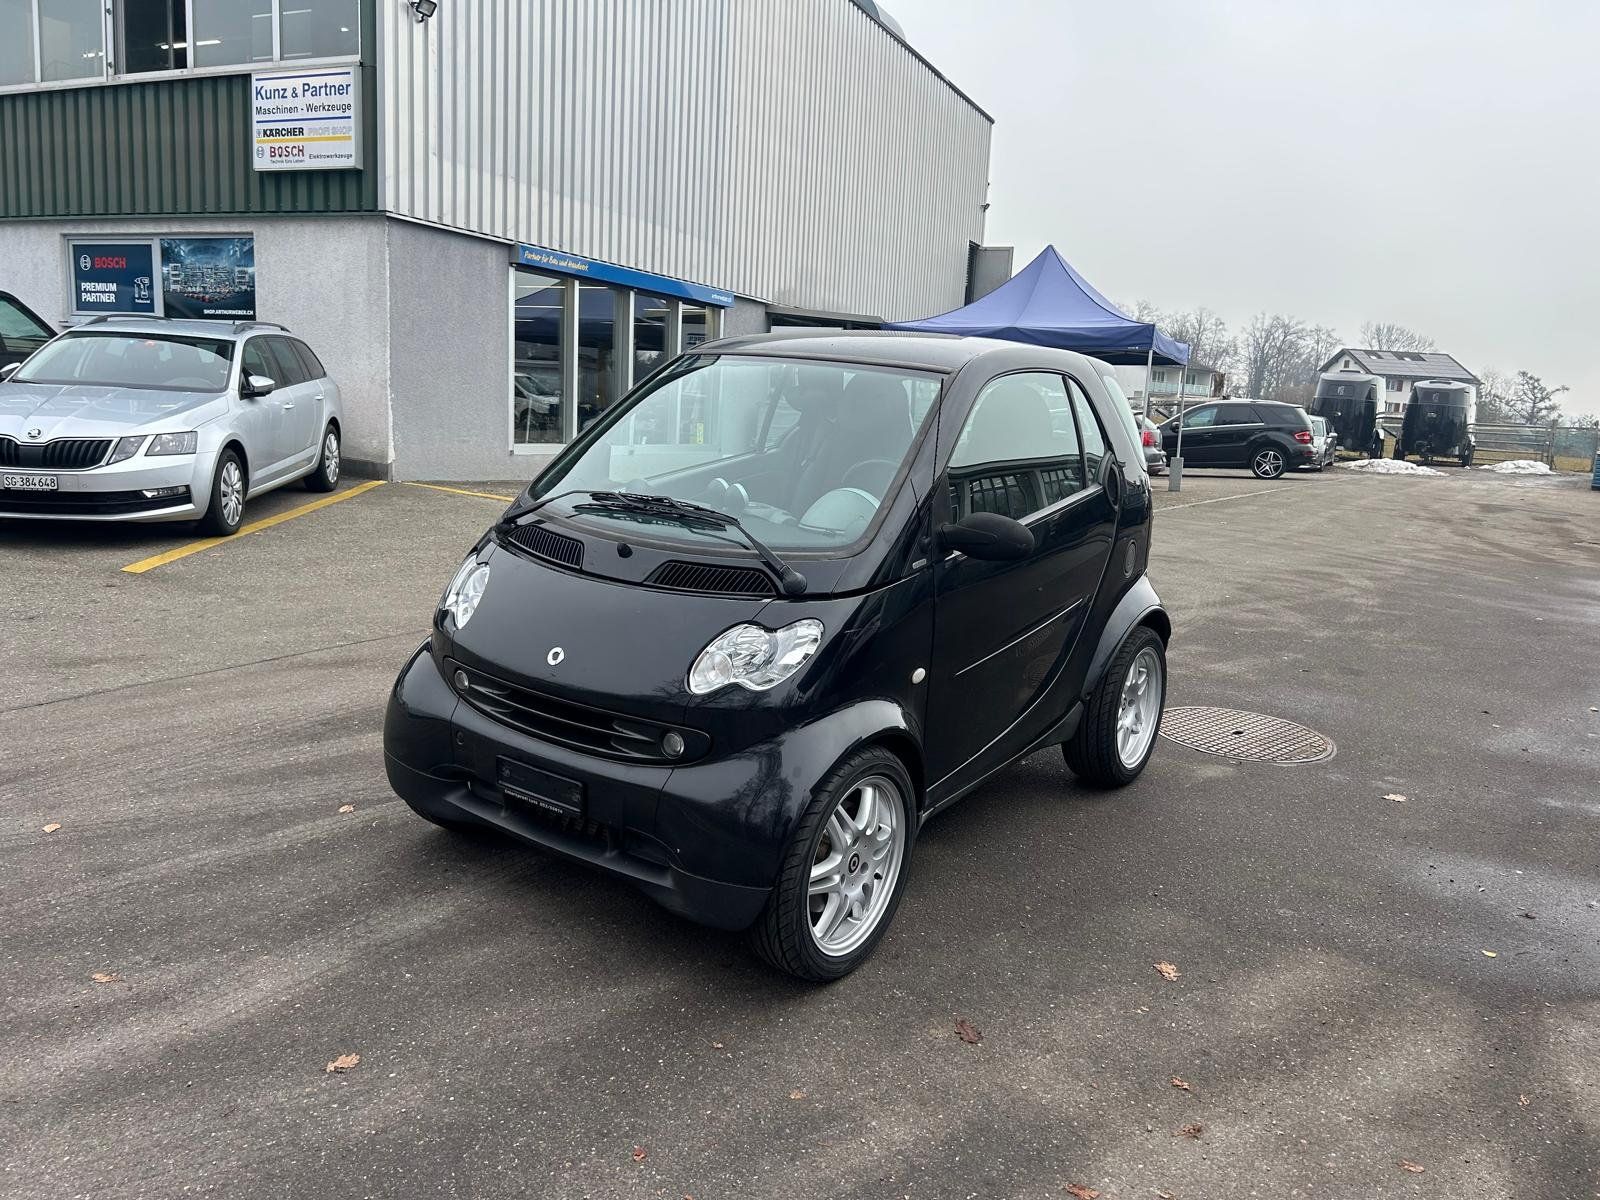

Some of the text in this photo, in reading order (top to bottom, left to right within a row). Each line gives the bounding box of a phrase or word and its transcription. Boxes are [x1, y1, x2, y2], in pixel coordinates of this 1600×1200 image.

[255, 82, 351, 101] Kunz & Partner
[255, 104, 299, 115] Maschinen
[305, 102, 352, 113] Werkzeuge
[262, 127, 304, 138] KÄRCHER
[269, 145, 305, 158] BOSCH
[94, 257, 127, 269] BOSCH
[81, 282, 117, 292] PREMIUM
[81, 292, 116, 303] PARTNER
